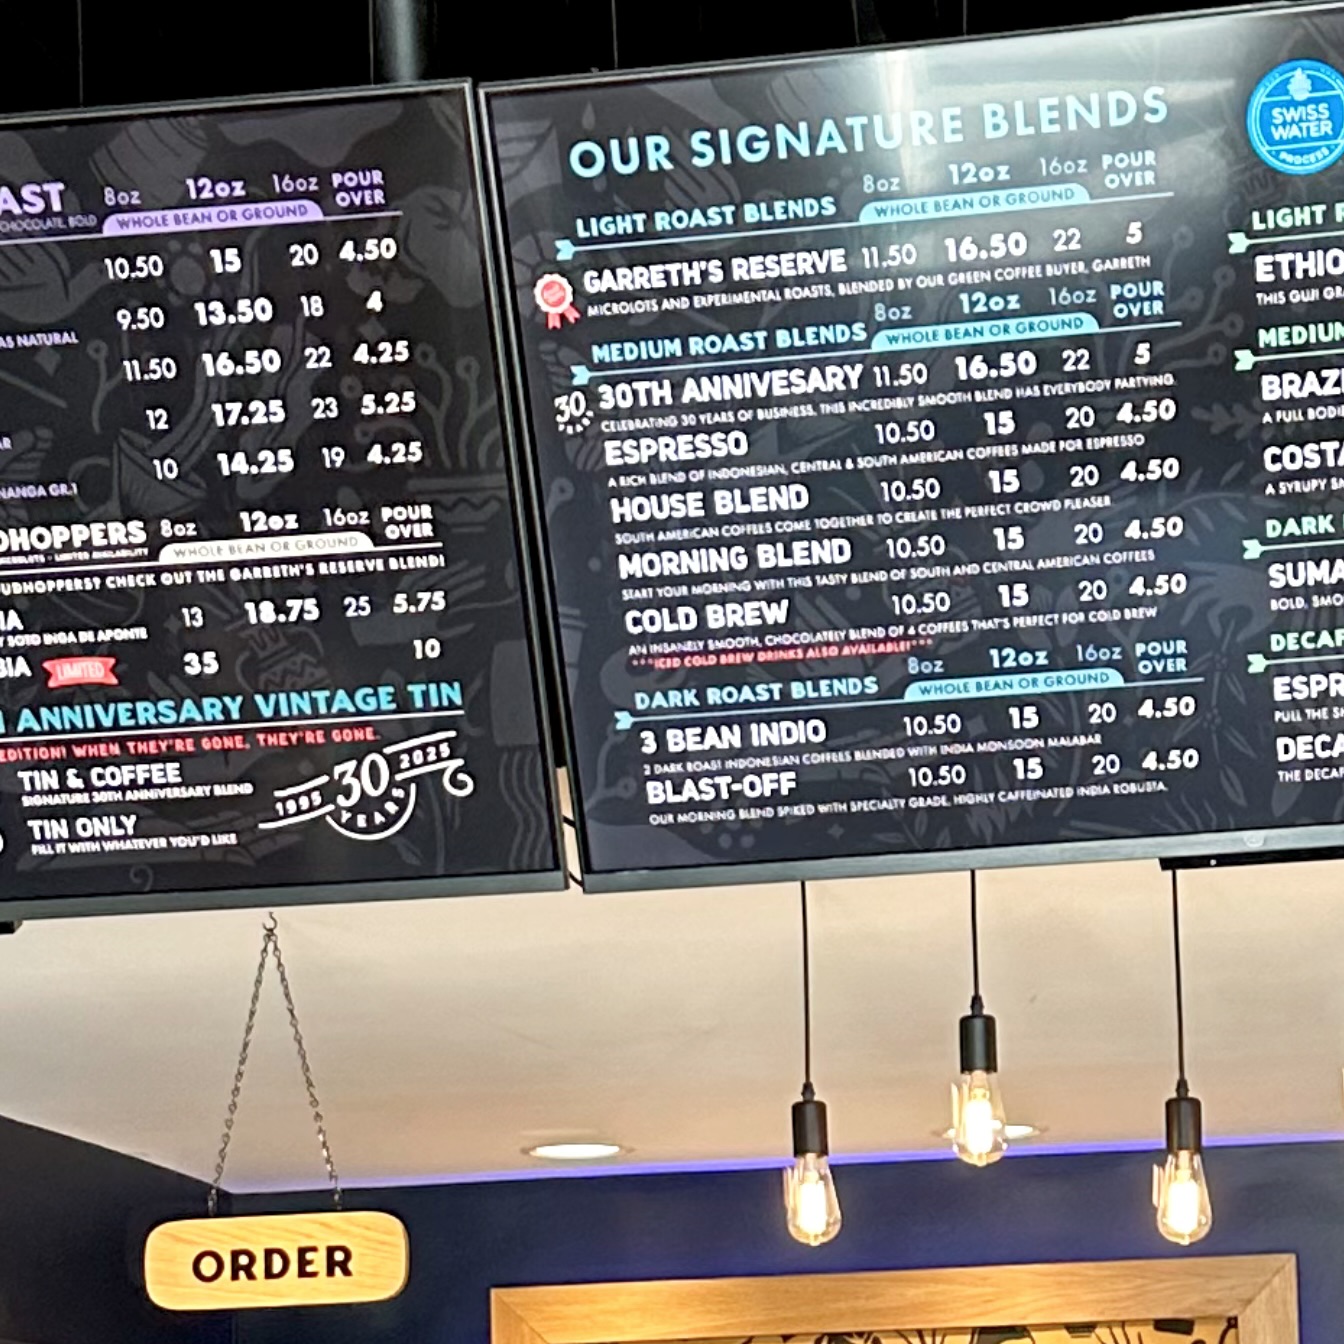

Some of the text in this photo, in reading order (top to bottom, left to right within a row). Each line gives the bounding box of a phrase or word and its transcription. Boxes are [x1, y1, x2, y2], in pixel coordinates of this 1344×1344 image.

[570, 85, 1169, 177] OUR SIGNATURE BLENDS
[1270, 103, 1333, 140] SWISS WATER
[576, 196, 836, 238] LIGHT ROAST BLENDS
[1252, 204, 1326, 230] LIGHT
[583, 221, 1142, 293] GARRETH'S RESERVE 11.50 16.50 22 5
[592, 322, 867, 363] MEDIUM ROAST BLENDS
[598, 364, 863, 409] 30TH ANNIVESARY
[604, 430, 748, 465] ESPRESSO
[610, 484, 808, 523] HOUSE BLEND
[1266, 514, 1335, 538] DARK
[619, 538, 851, 579] MORNING BLEND
[625, 599, 788, 634] COLD BREW
[17, 695, 243, 732] ANNIVERSARY
[254, 686, 396, 718] VINTAGE
[407, 682, 462, 708] TIN
[635, 676, 878, 710] DARK ROAST BLENDS
[72, 742, 121, 757] WHEN
[126, 738, 195, 754] THEY'RE
[256, 730, 326, 746] THEY'RE
[640, 719, 826, 754] 3 BEAN INDIO
[400, 742, 450, 769] 2025
[17, 770, 59, 791] TIN
[66, 768, 85, 789] &
[90, 763, 182, 787] COFFEE
[334, 753, 389, 807] 30
[646, 771, 796, 804] BLAST-OFF
[275, 791, 321, 816] 1995
[27, 819, 69, 840] TIN
[75, 815, 136, 838] ONLY
[192, 1244, 354, 1283] ORDER
